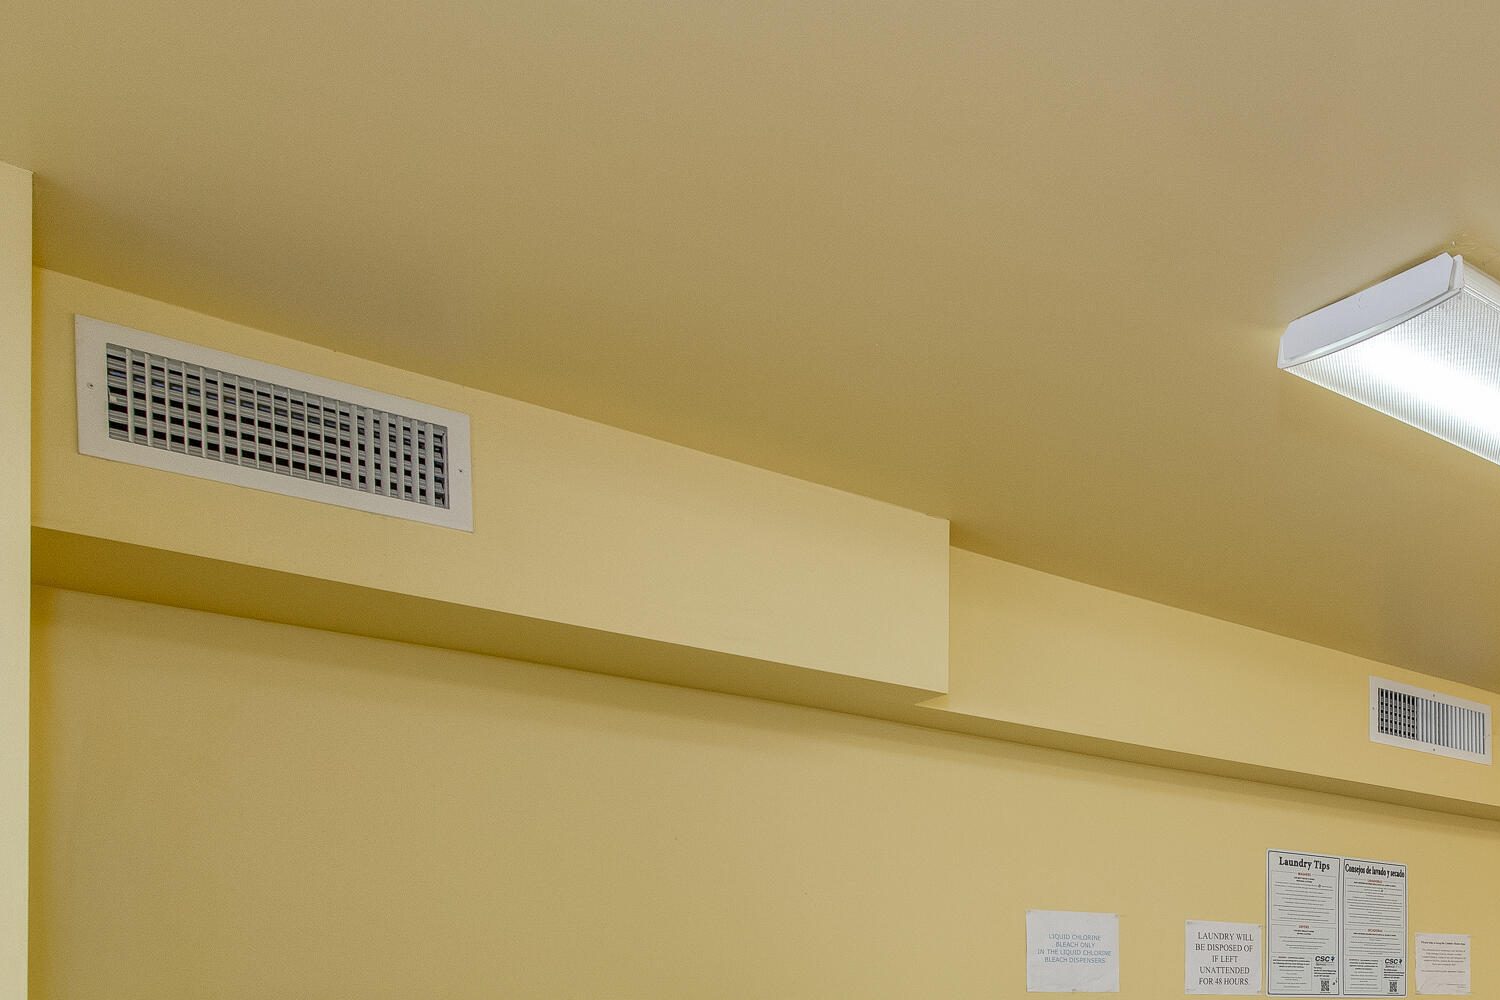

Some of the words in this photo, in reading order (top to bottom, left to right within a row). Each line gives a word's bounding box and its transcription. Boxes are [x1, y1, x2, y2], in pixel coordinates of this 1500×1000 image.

[1279, 857, 1312, 870] Laundry
[1314, 860, 1330, 872] Tips
[1345, 864, 1365, 875] Consejos
[1366, 866, 1371, 874] de
[1372, 867, 1386, 876] lavado
[1387, 870, 1390, 878] y
[1198, 932, 1234, 940] LAUNDRY
